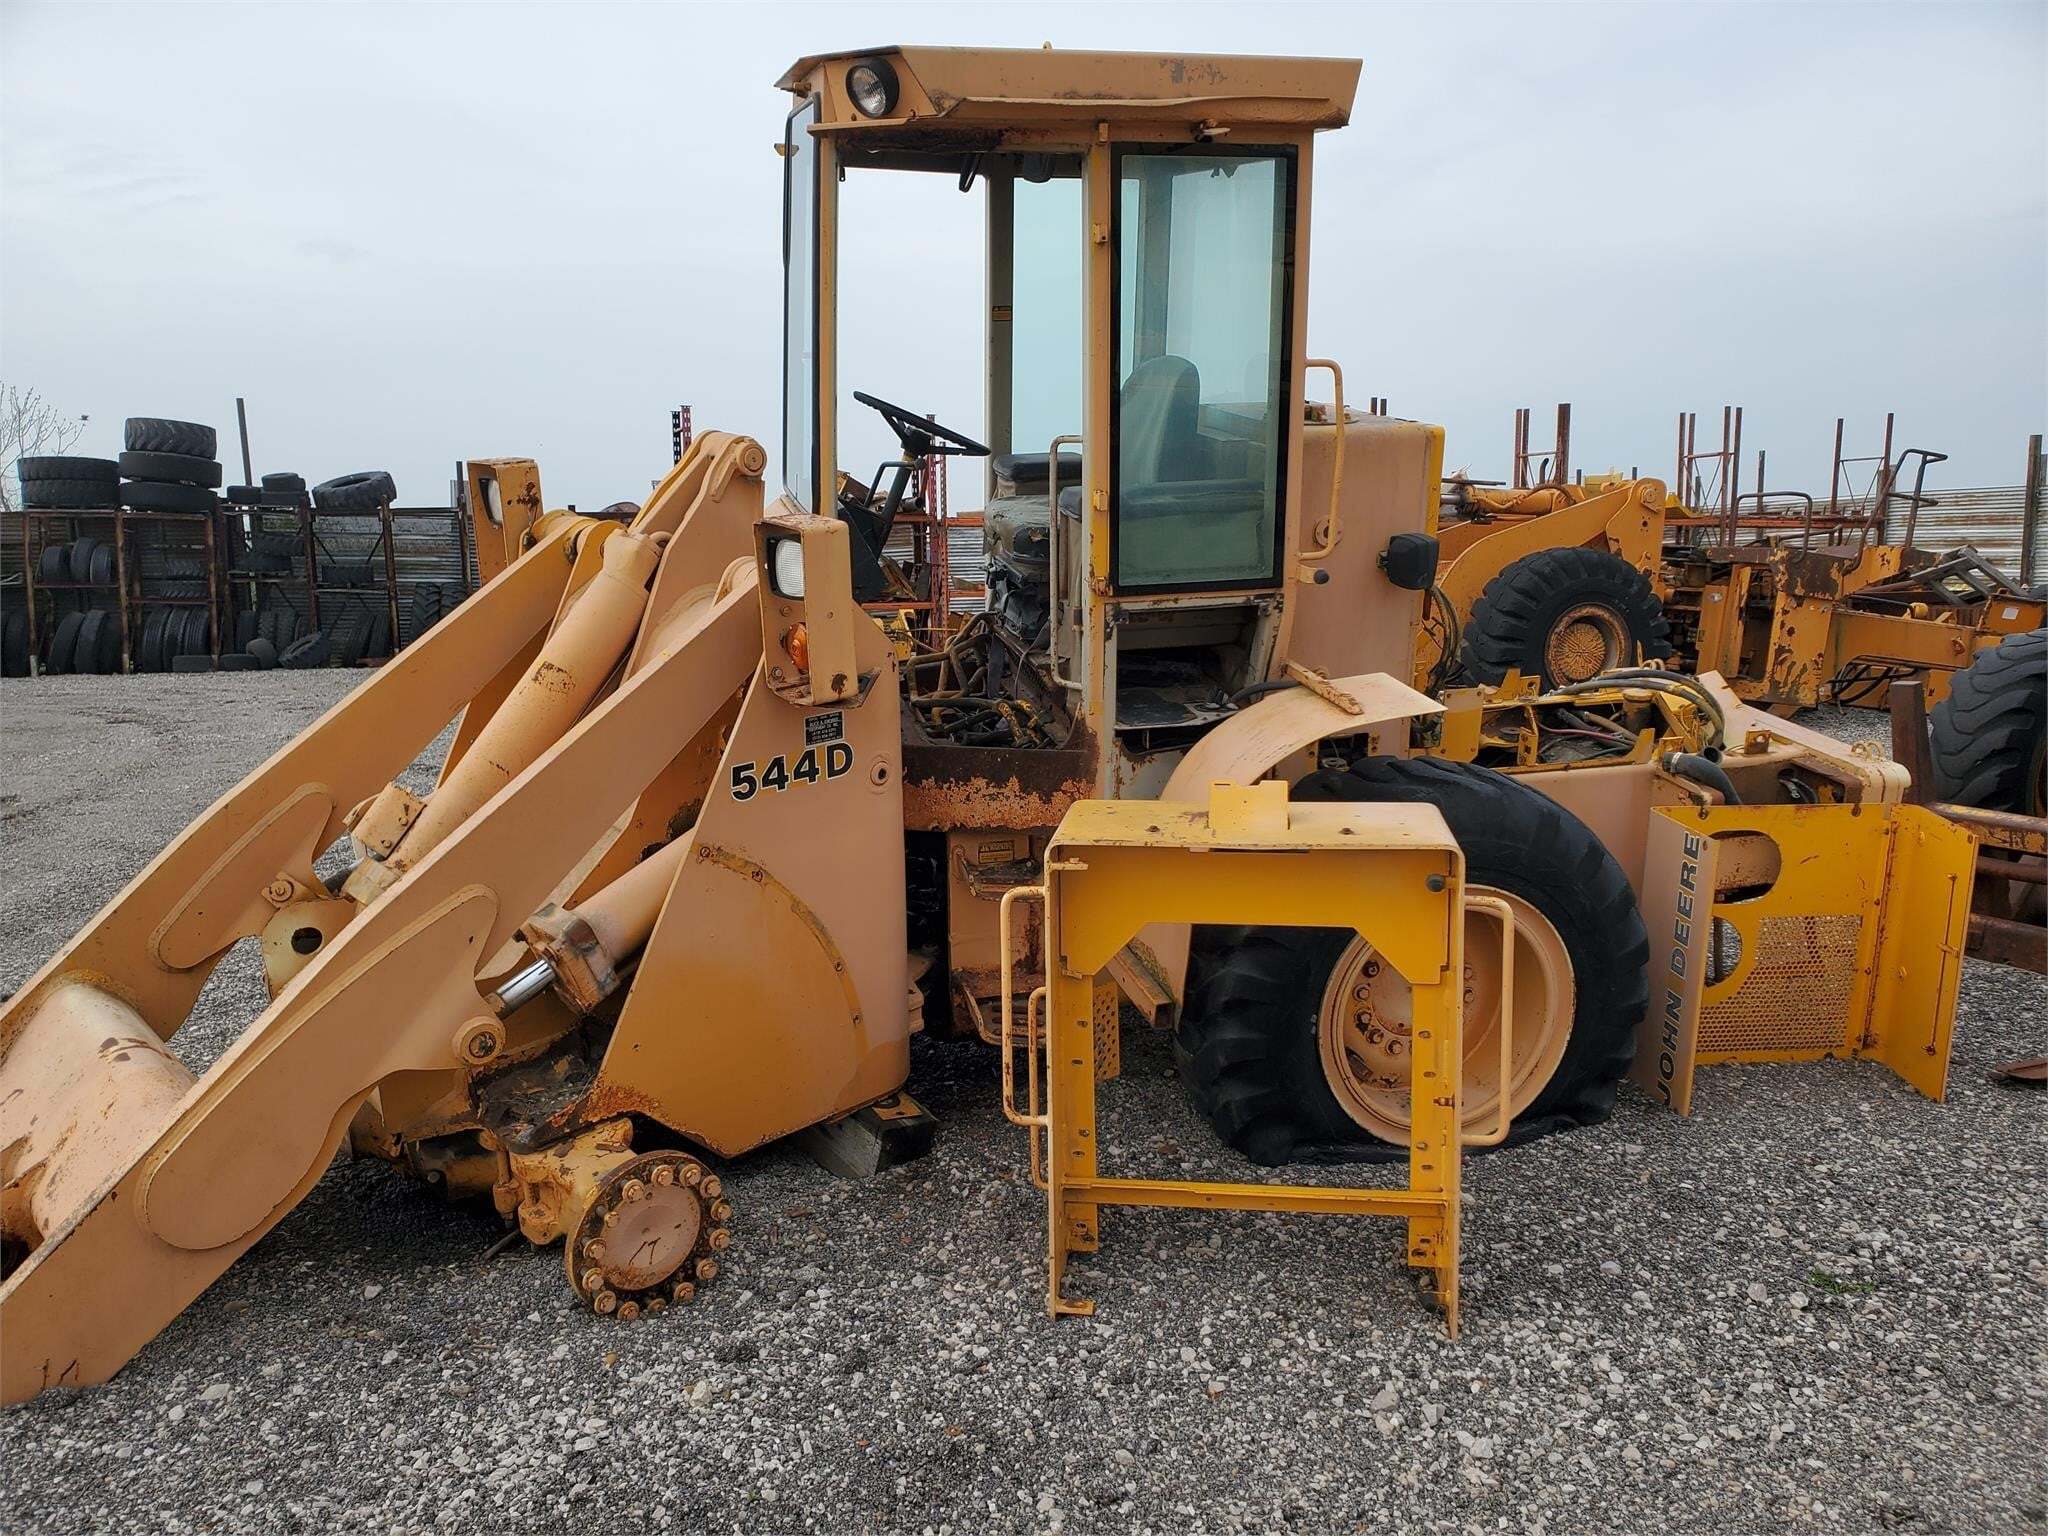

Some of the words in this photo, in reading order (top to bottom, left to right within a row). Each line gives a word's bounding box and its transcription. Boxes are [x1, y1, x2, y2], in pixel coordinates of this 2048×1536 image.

[731, 741, 854, 801] 544D
[1655, 991, 1682, 1106] JOHN
[1669, 830, 1701, 981] DEERE
